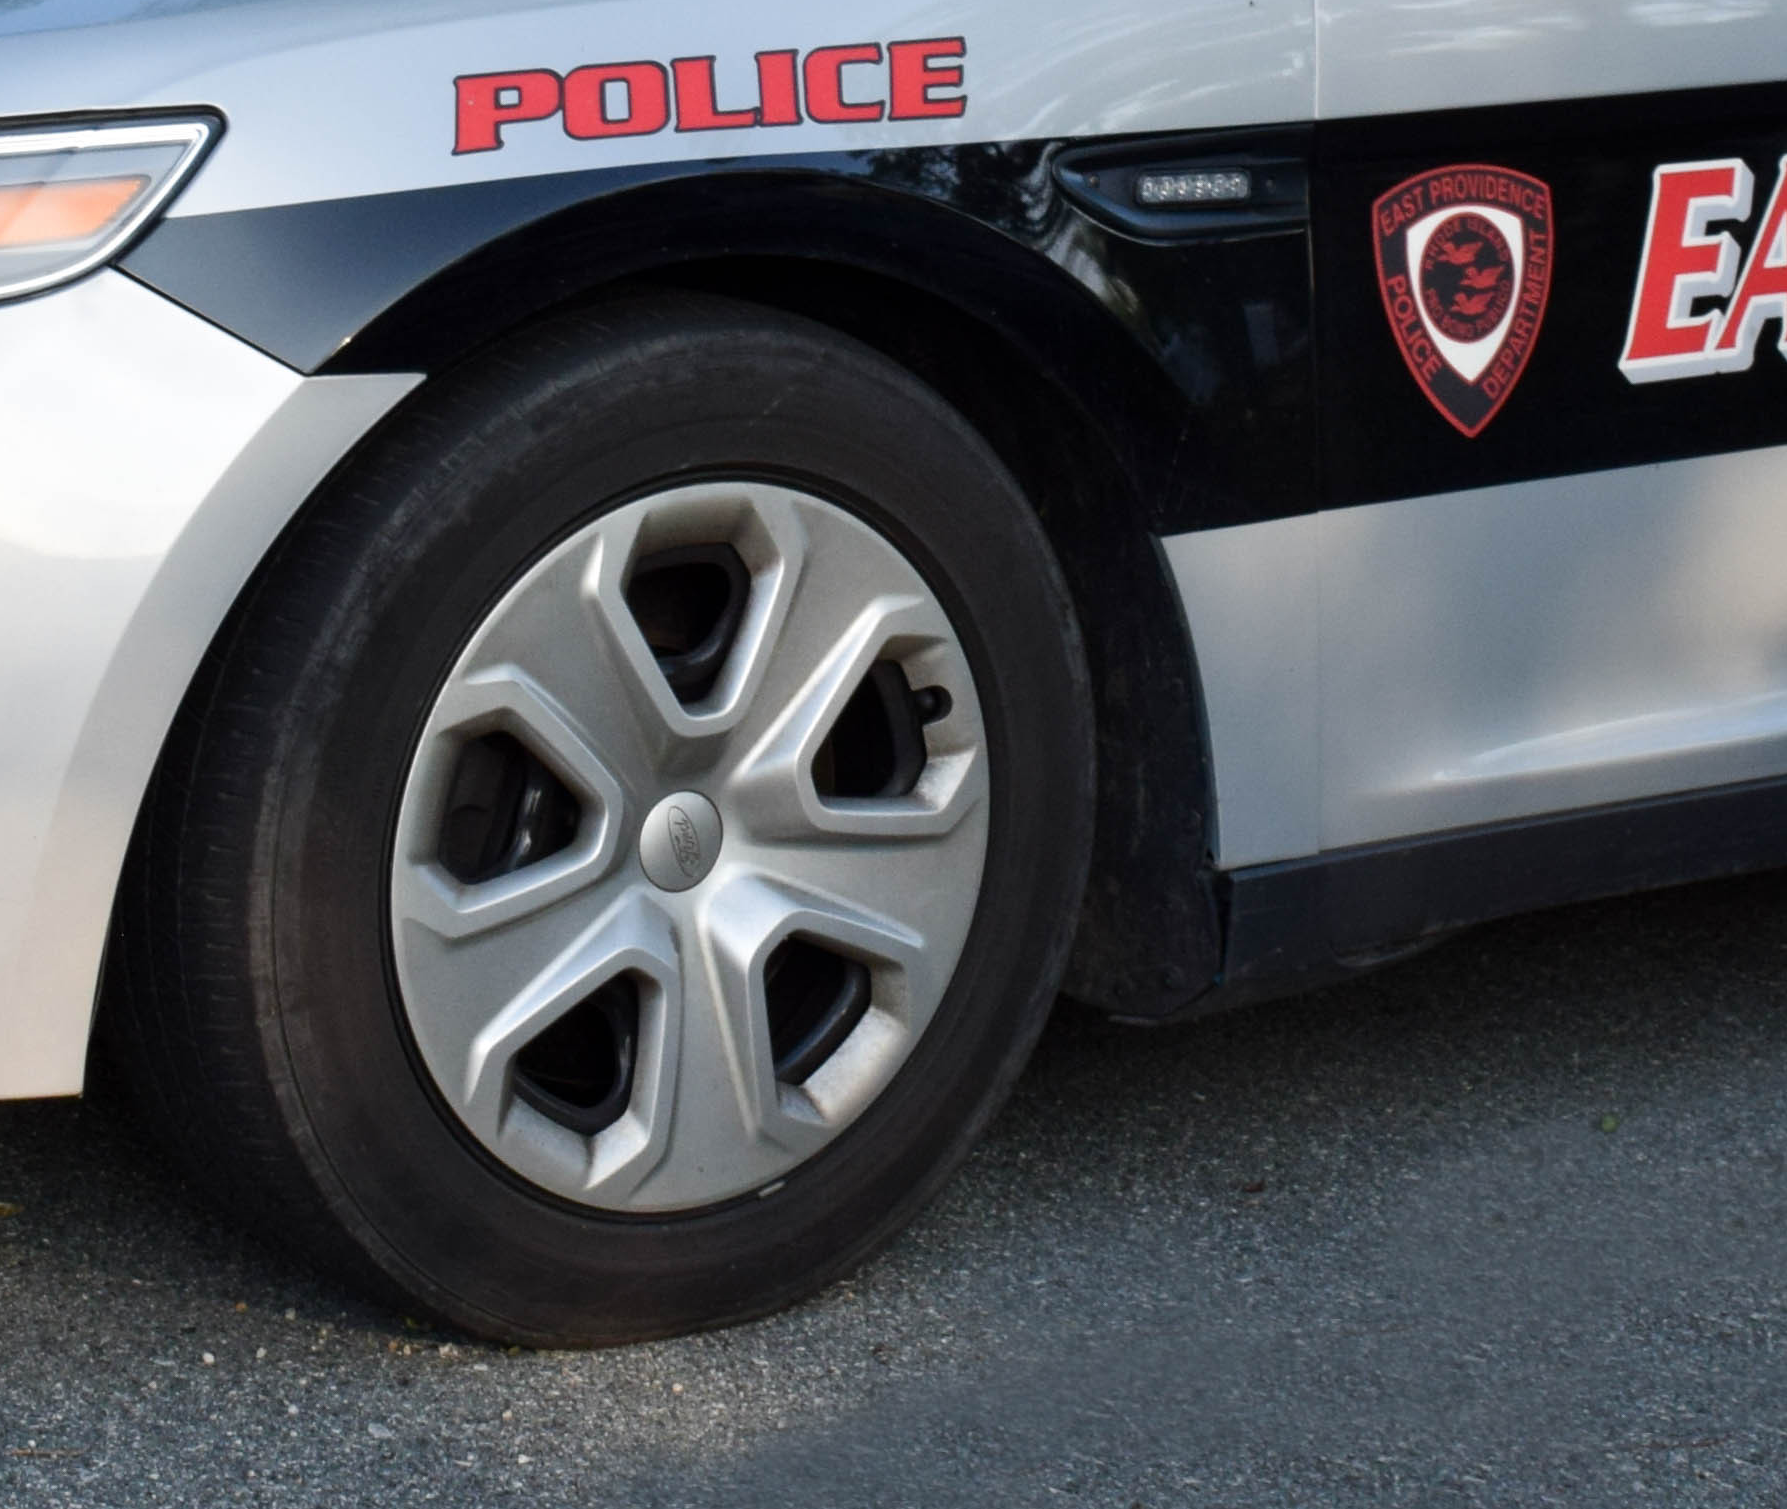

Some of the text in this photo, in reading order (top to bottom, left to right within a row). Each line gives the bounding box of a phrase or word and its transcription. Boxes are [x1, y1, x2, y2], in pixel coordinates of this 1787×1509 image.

[451, 36, 968, 156] POLICE
[1378, 173, 1548, 237] EAST PROVIDENCE
[1385, 274, 1443, 382] POLICE
[1481, 230, 1548, 401] DEPARTMENT
